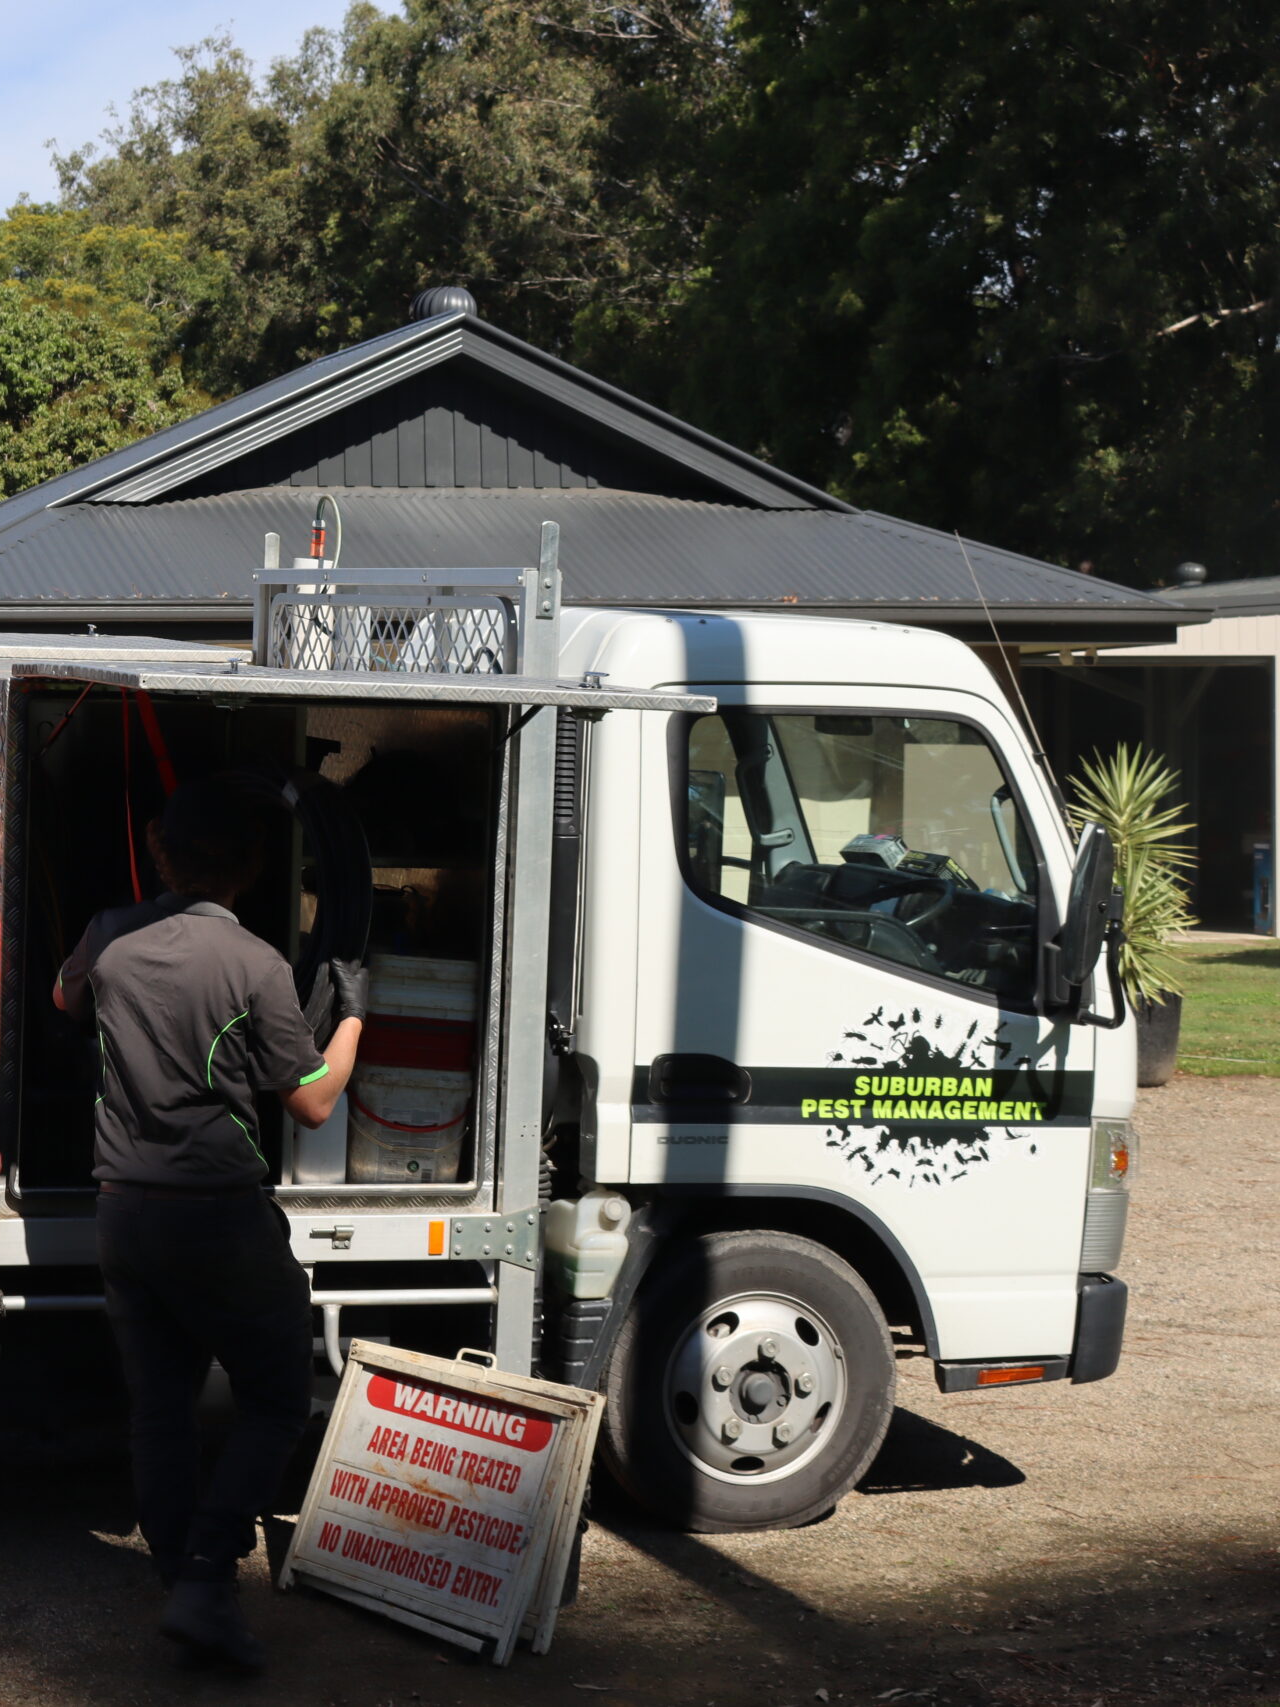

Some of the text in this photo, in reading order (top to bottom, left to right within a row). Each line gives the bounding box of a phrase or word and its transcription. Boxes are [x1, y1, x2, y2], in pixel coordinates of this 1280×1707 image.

[801, 1099, 1046, 1121] PEST MANAGEMENT
[854, 1075, 992, 1097] SUBURBAN
[393, 1381, 526, 1441] WARNING
[367, 1425, 522, 1494] AREA BEING TREATED
[329, 1468, 369, 1501] WITH
[366, 1481, 445, 1531] APPROVED
[317, 1521, 341, 1552] NO
[342, 1534, 452, 1589] UNAUTHORISED
